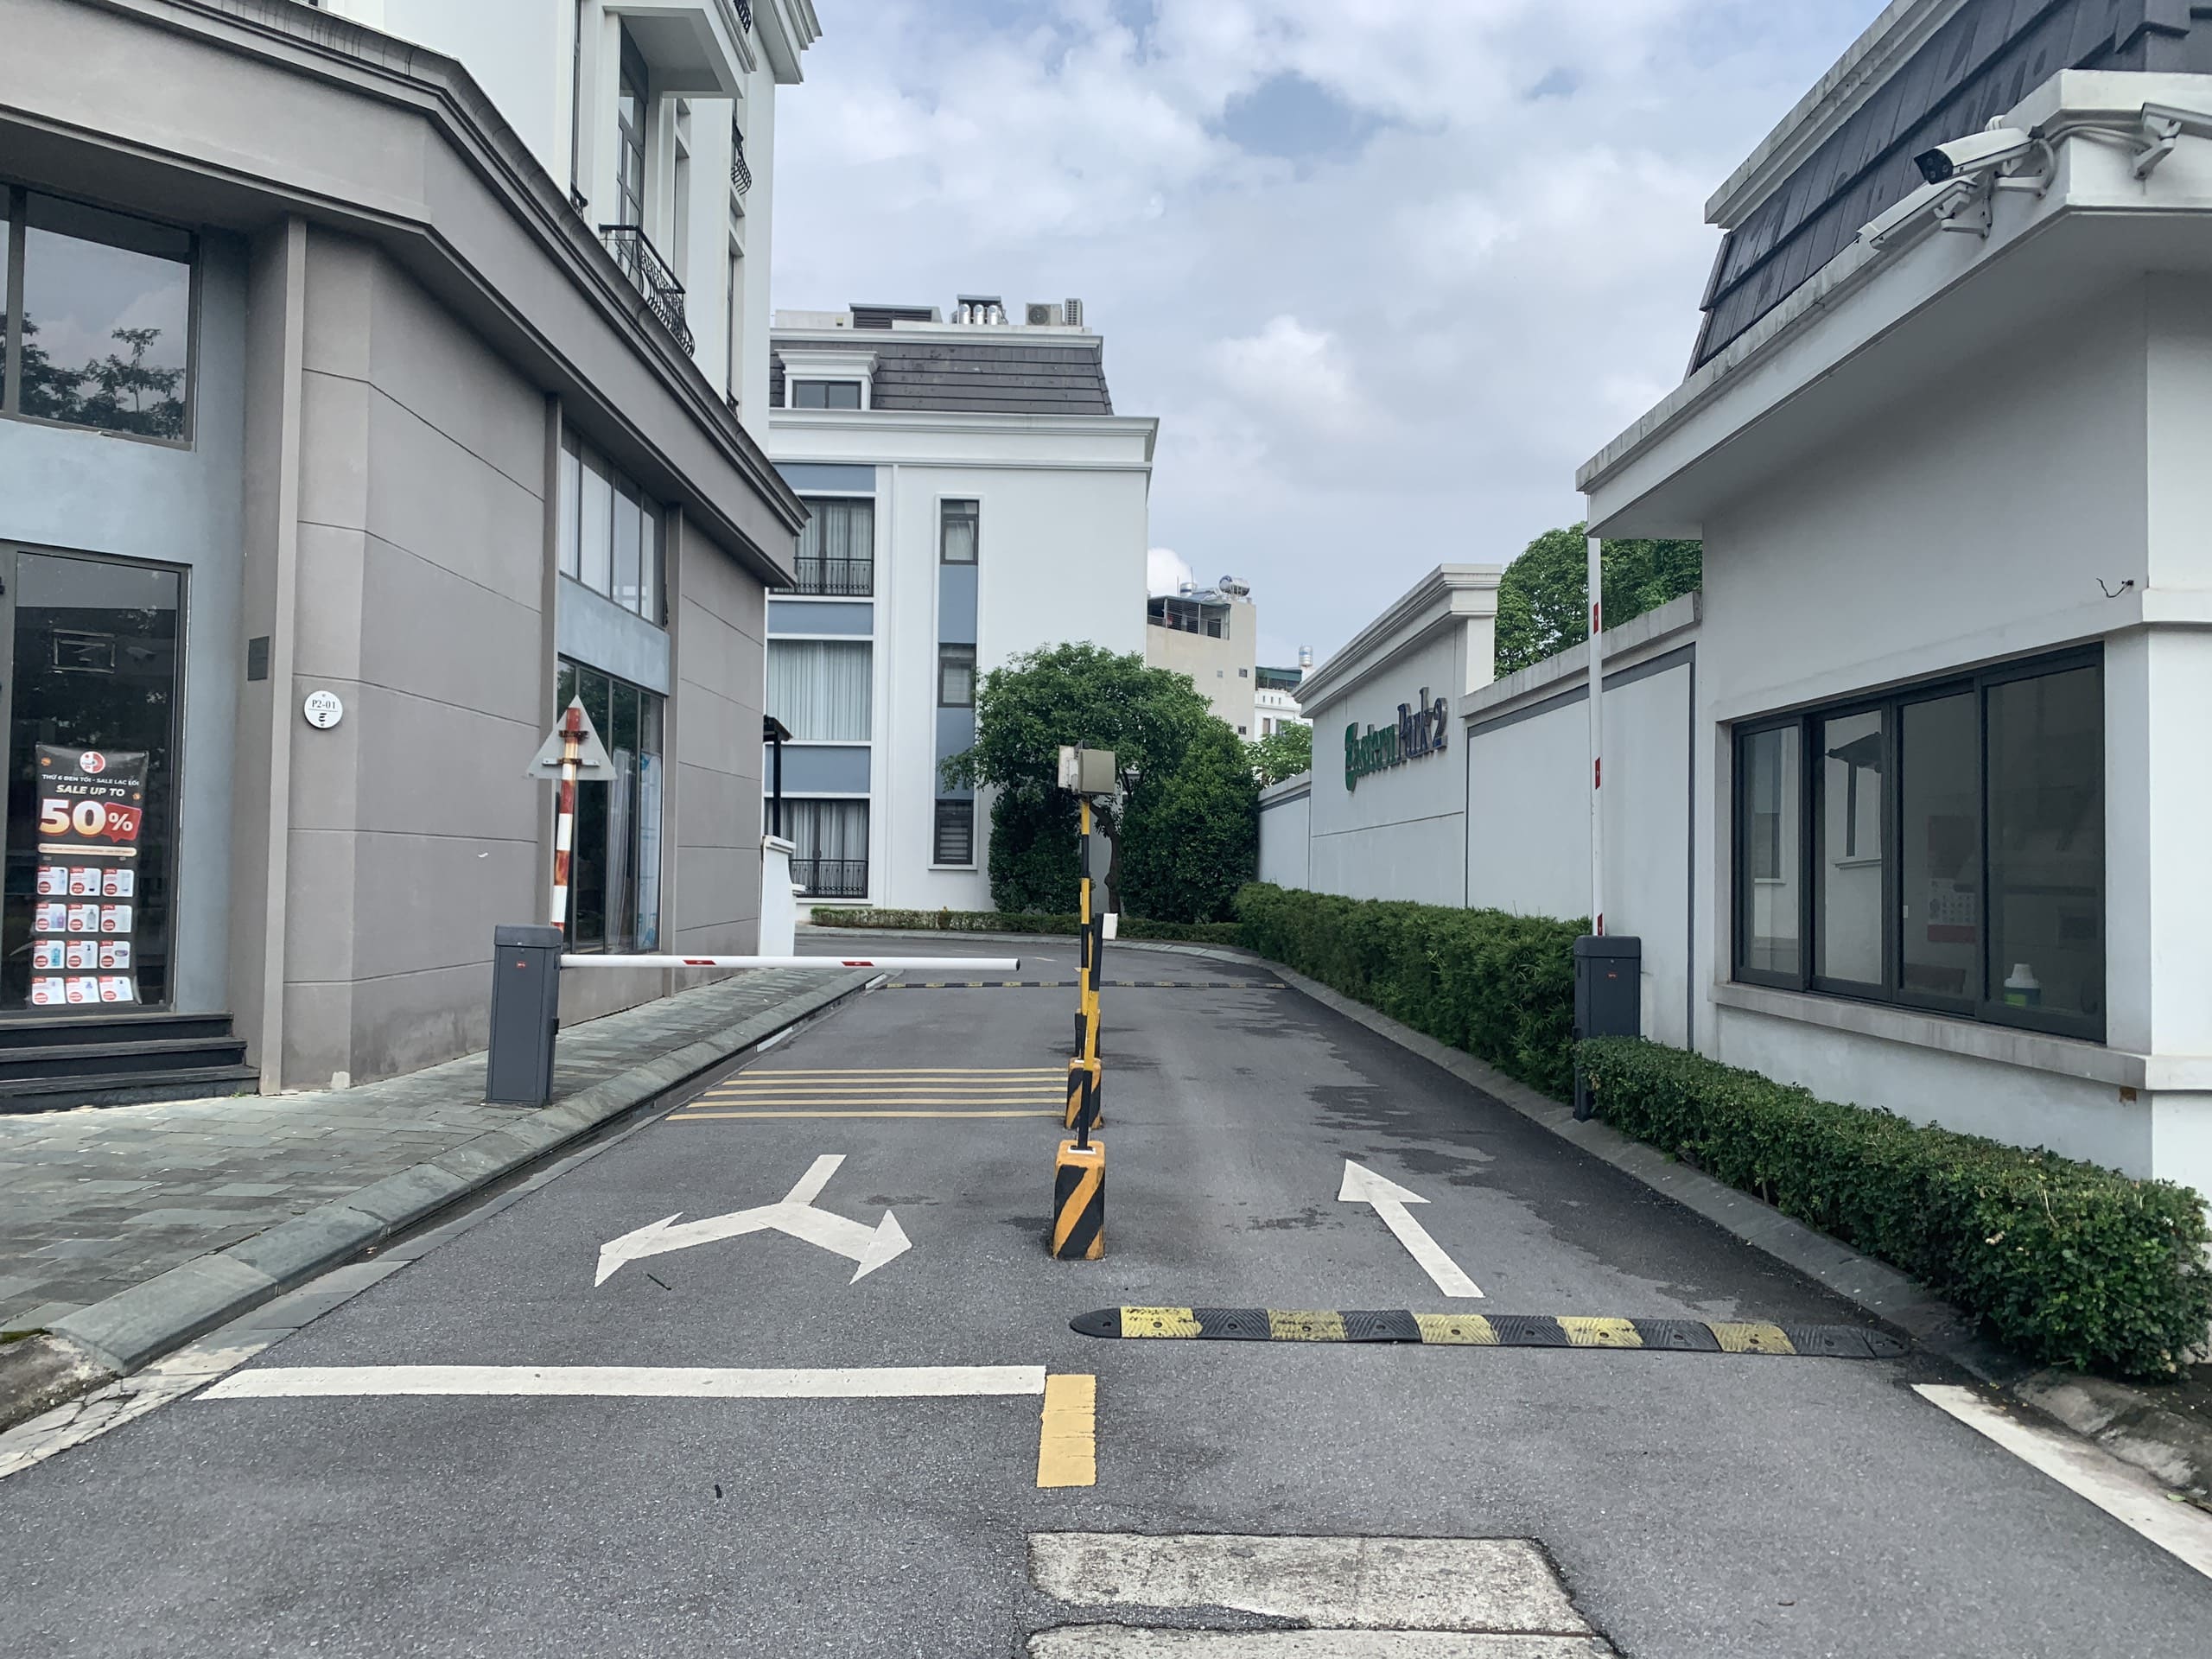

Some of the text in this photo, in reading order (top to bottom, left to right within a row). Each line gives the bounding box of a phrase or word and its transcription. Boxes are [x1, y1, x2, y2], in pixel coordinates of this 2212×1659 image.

[312, 699, 335, 709] P2-01
[56, 785, 125, 797] SALE UP TO
[39, 798, 133, 836] 50%
